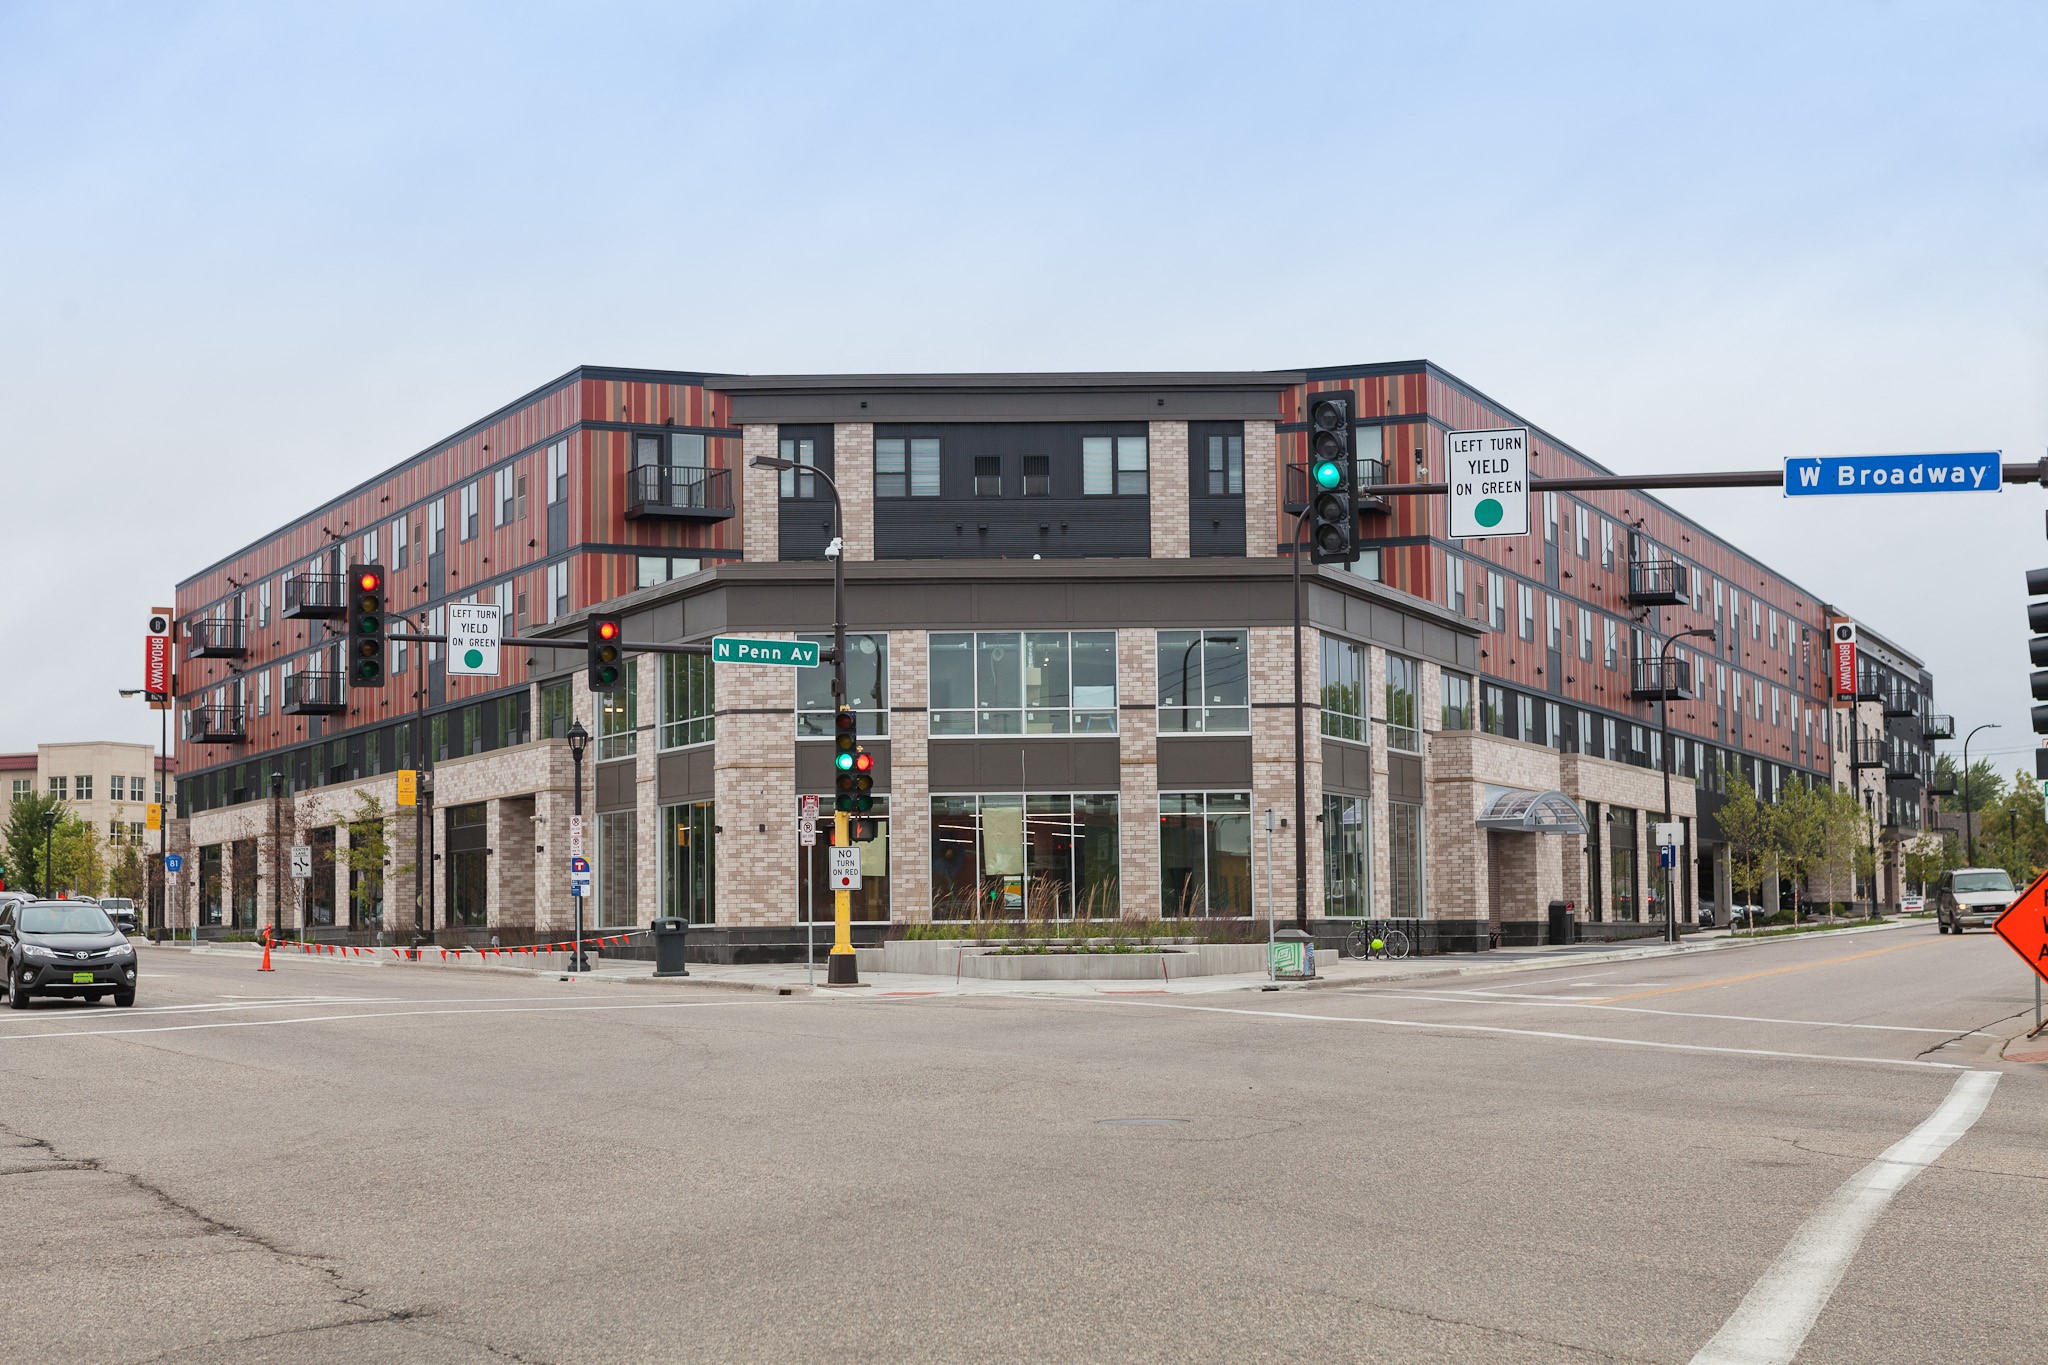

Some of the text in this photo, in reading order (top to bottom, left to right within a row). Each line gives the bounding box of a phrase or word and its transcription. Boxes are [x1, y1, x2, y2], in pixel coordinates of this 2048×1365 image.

[1454, 437, 1522, 453] LEFT TURN
[1468, 458, 1509, 475] YIELD
[1799, 463, 1987, 489] W Broadway
[1456, 480, 1522, 496] ON GREEN
[452, 609, 497, 619] LEFT TURN
[461, 623, 488, 634] YIELD
[452, 637, 496, 647] ON GREEN
[718, 643, 813, 661] N Penn Av
[151, 637, 164, 691] BROADWAY
[1840, 644, 1852, 691] BROADWAY
[838, 850, 852, 858] NO
[169, 859, 178, 867] 81
